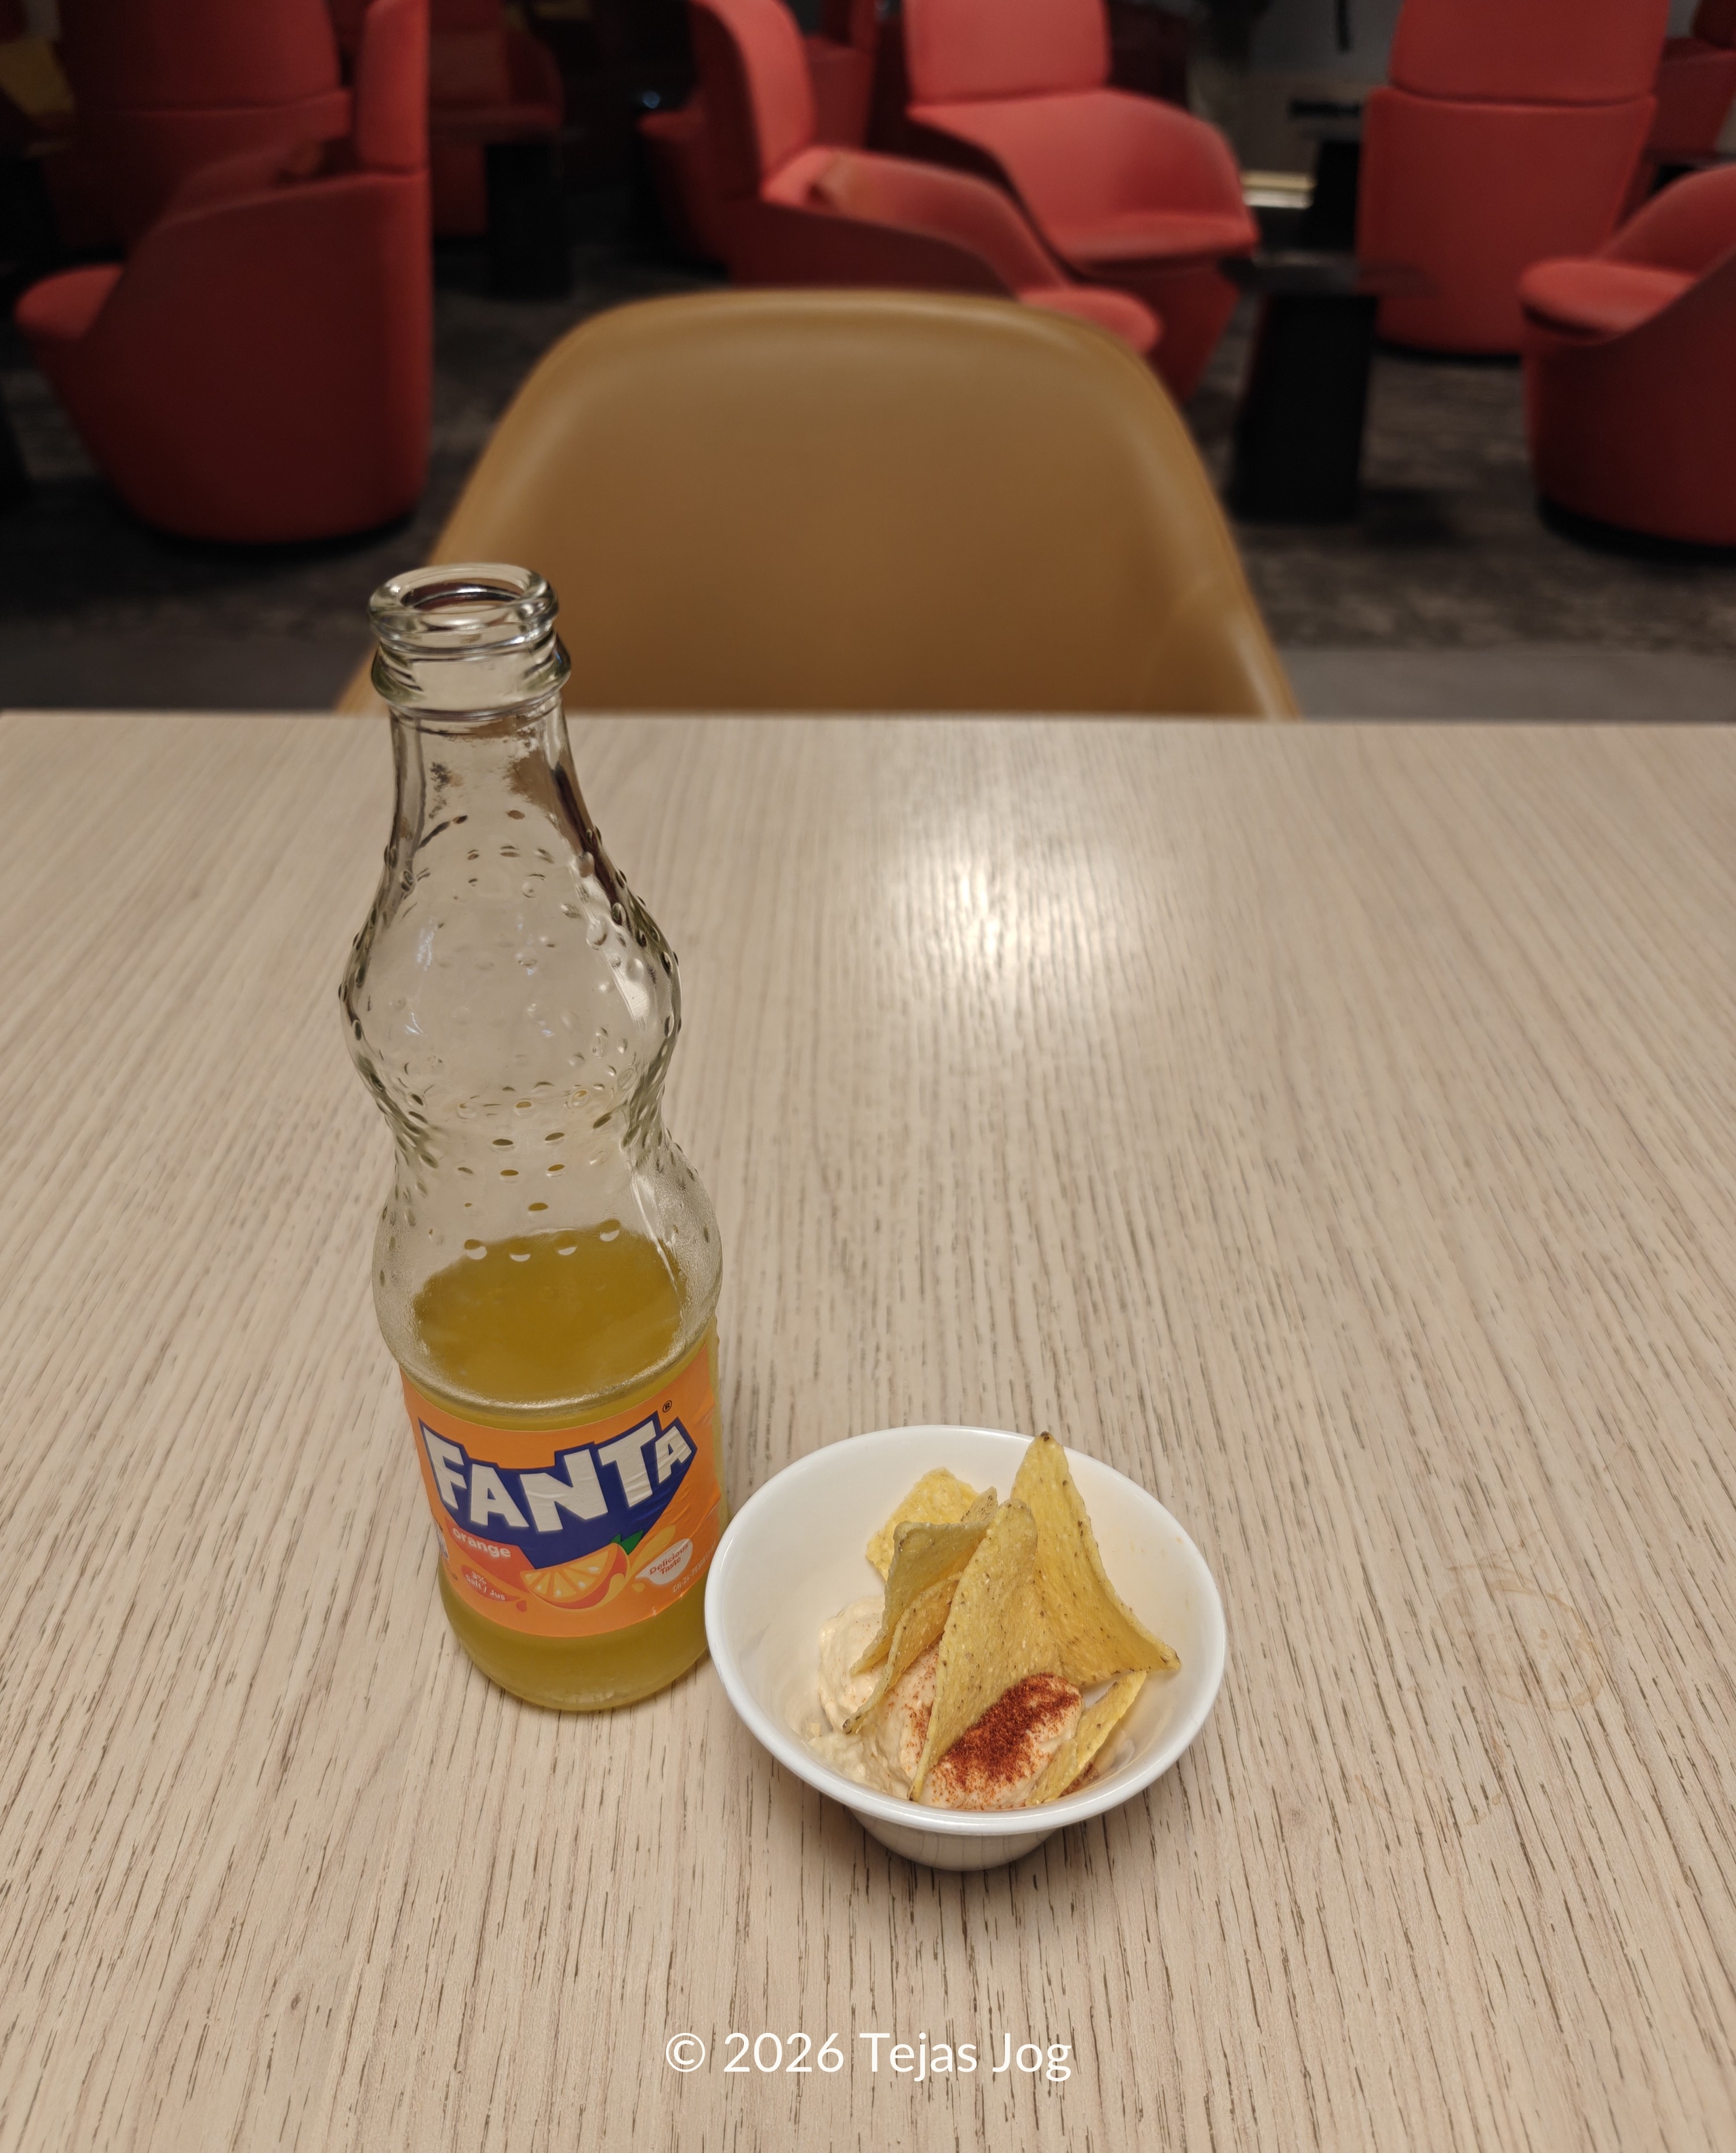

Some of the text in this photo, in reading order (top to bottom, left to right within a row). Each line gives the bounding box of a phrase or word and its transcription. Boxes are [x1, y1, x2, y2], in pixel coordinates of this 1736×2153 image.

[422, 1419, 692, 1533] FANTA
[452, 1527, 511, 1558] orange
[649, 1543, 689, 1575] Delicious
[660, 1556, 682, 1575] Taste
